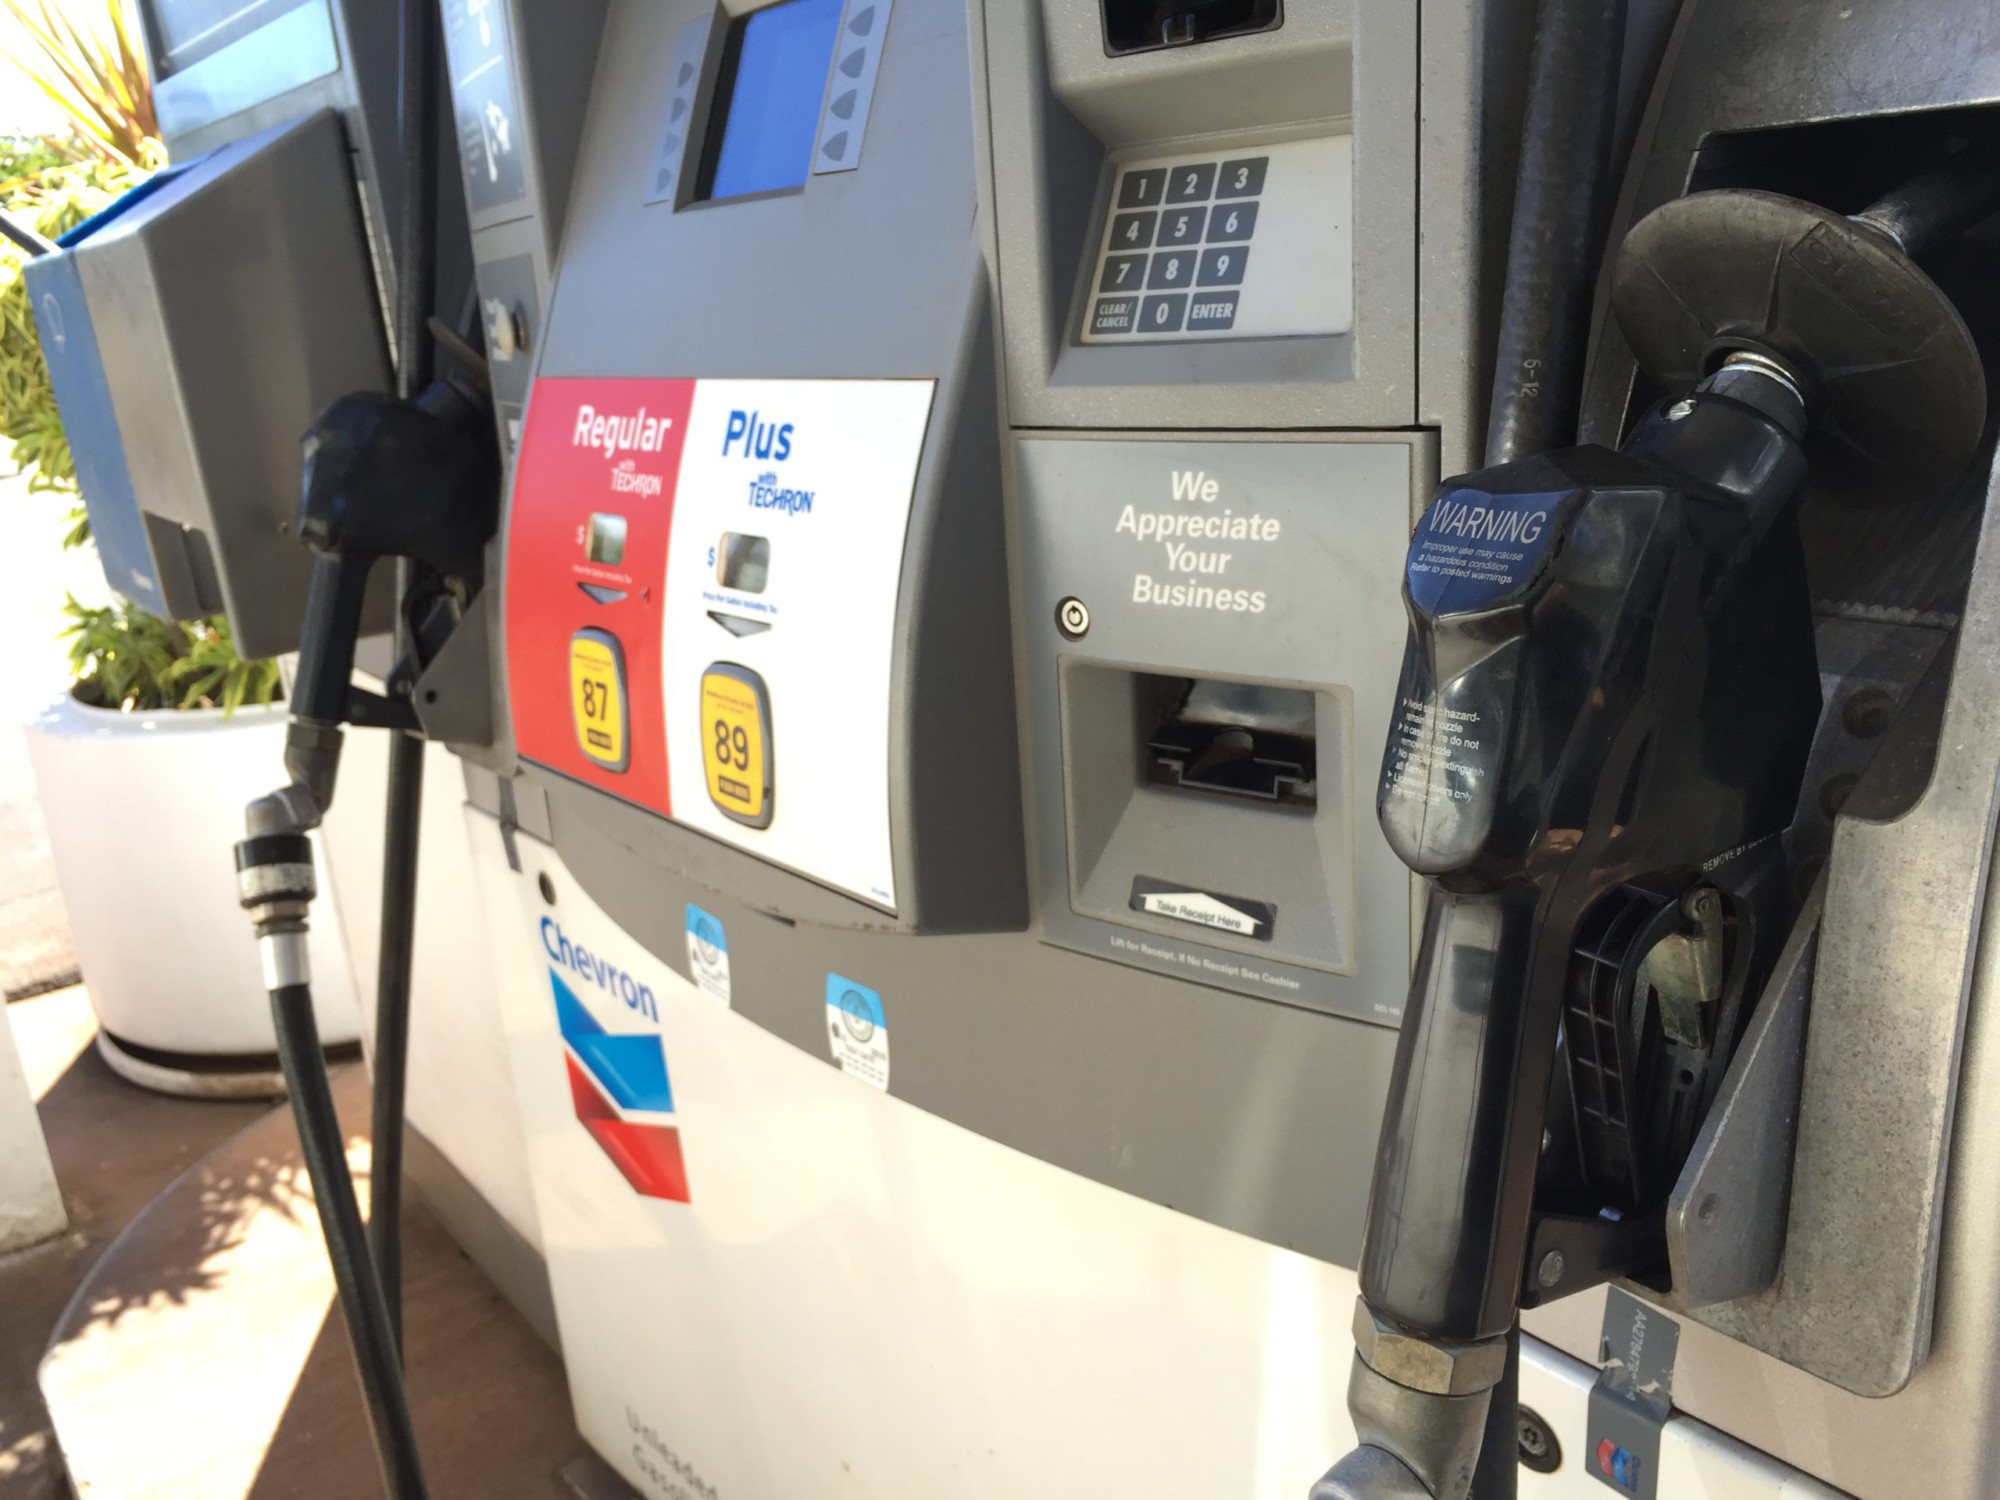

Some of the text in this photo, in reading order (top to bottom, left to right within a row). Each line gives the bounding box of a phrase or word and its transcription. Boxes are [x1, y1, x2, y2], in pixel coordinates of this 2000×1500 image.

[1138, 167, 1249, 199] 1 2 3
[1126, 212, 1238, 241] 4 5 6
[1116, 255, 1229, 284] 7 8 9
[1096, 316, 1129, 328] CANCEL
[1156, 303, 1169, 324] 0
[1191, 303, 1233, 320] ENTER
[572, 404, 672, 459] Regular
[722, 410, 795, 461] Plus
[619, 459, 636, 472] with
[758, 471, 778, 486] with
[748, 482, 816, 516] TECHRON
[1171, 470, 1219, 502] We
[1115, 504, 1281, 542] Appreciate
[1429, 499, 1547, 544] WARNING
[707, 546, 716, 568] $
[1165, 541, 1232, 574] Your
[1422, 540, 1524, 561] Improper use may cause
[1425, 554, 1467, 567] hazardous
[1468, 560, 1508, 572] condition
[1410, 562, 1513, 584] Refer to posted warnings
[1132, 574, 1267, 613] Business
[583, 678, 608, 721] 87
[1444, 707, 1481, 722] hazard-
[715, 719, 748, 772] 89
[1450, 735, 1462, 746] do
[1464, 739, 1480, 750] not
[1702, 850, 1735, 873] REMOVE
[1157, 899, 1241, 929] Take Receipt Here
[541, 915, 660, 1023] Chevron
[1187, 954, 1201, 967] No
[1203, 958, 1239, 976] Receipt
[1241, 967, 1260, 980] See
[1262, 972, 1300, 990] Cashier
